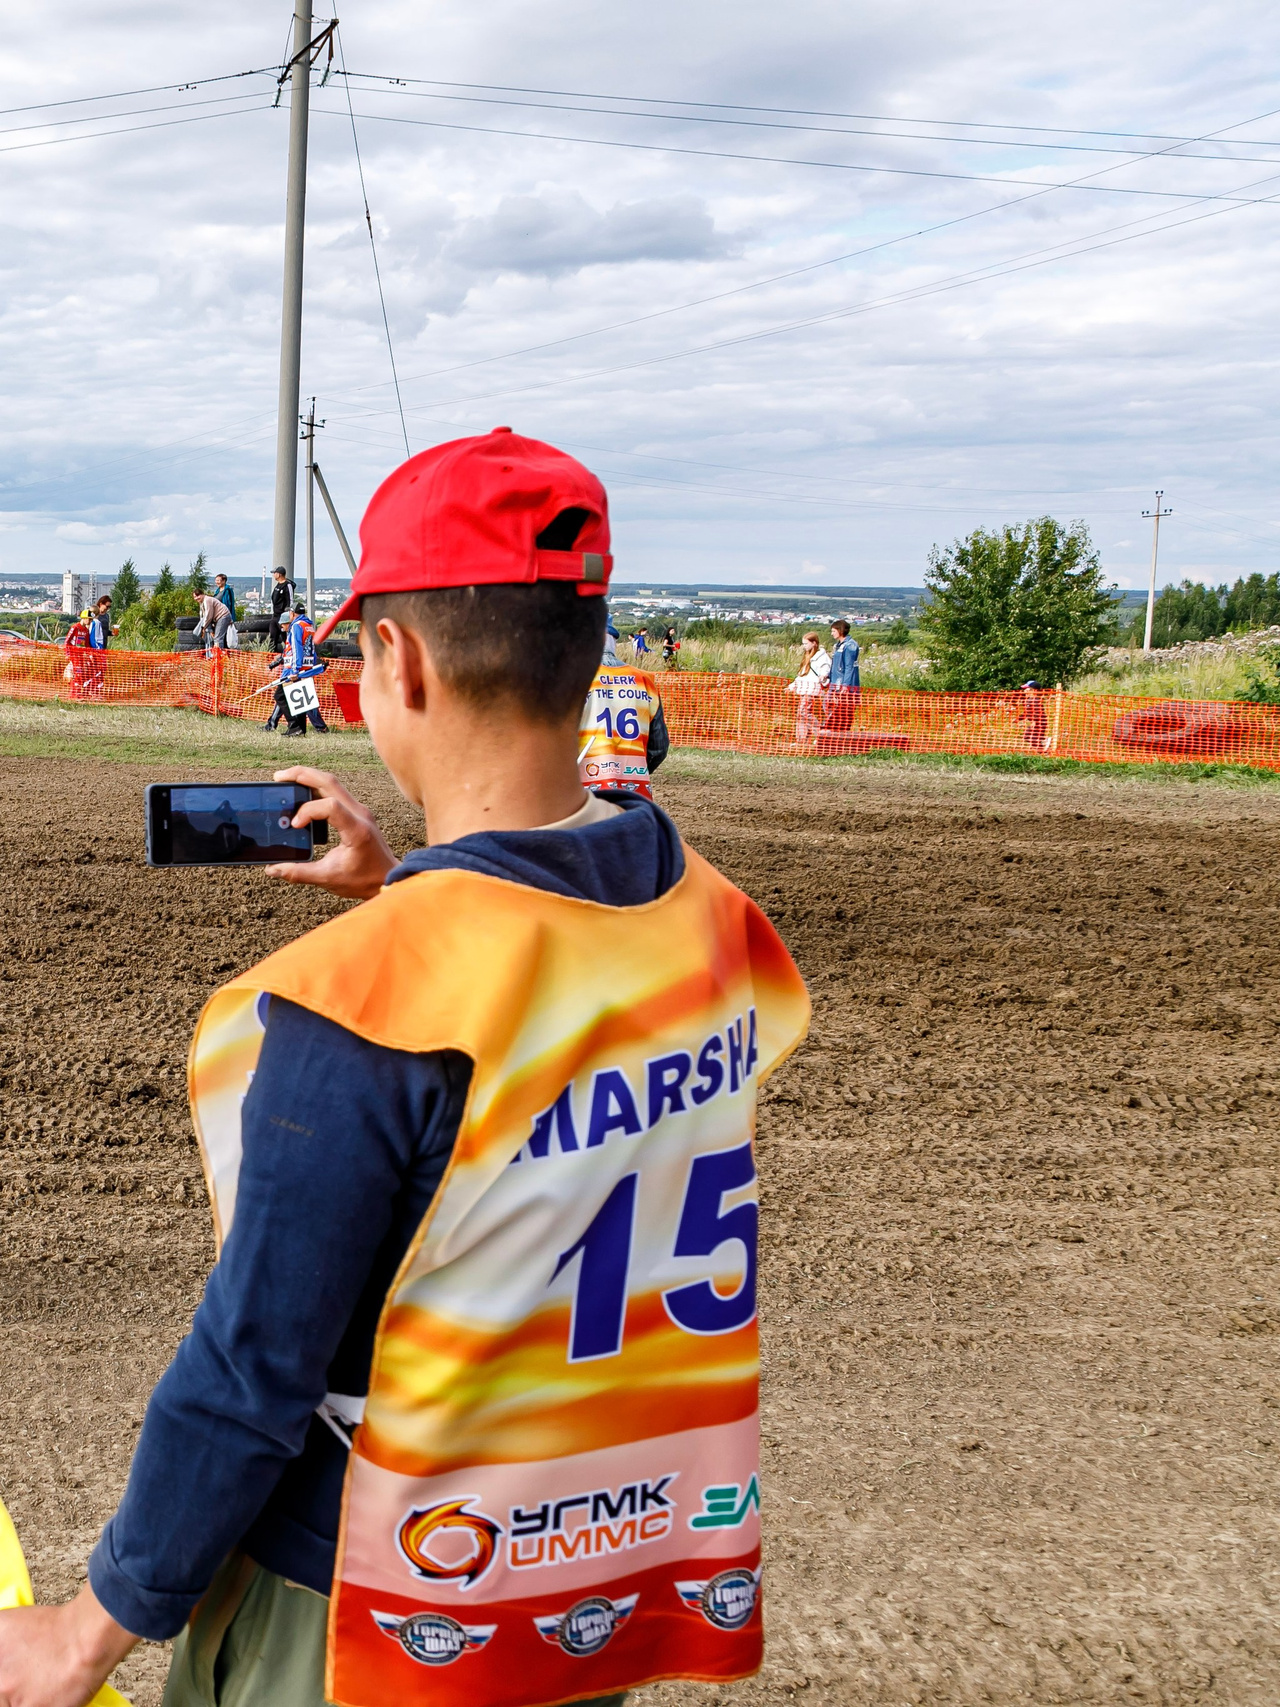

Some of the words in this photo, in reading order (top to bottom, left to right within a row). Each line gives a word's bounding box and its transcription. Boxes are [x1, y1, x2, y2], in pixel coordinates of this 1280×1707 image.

[595, 689, 614, 699] THE
[600, 675, 636, 685] CLERK
[289, 685, 315, 710] 15
[596, 707, 640, 740] 16
[547, 1138, 759, 1363] 15
[510, 1474, 677, 1537] УГМК
[510, 1509, 670, 1567] UMMC
